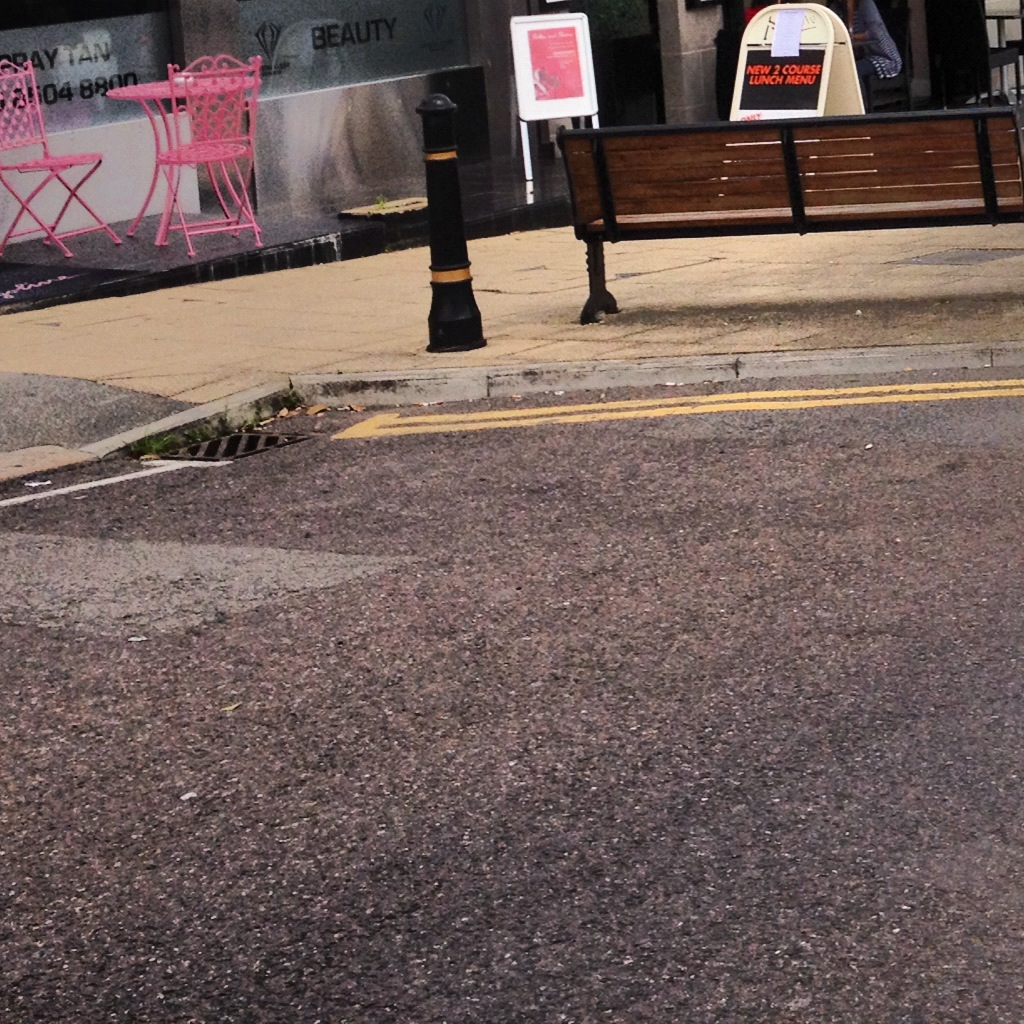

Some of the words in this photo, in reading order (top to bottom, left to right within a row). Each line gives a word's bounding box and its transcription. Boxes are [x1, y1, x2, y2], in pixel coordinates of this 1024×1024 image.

[311, 18, 398, 50] BEAUTY
[746, 65, 772, 75] NEW
[772, 65, 781, 75] 2
[782, 64, 821, 75] COURSE
[749, 75, 783, 85] LUNCH
[785, 75, 817, 85] MENU
